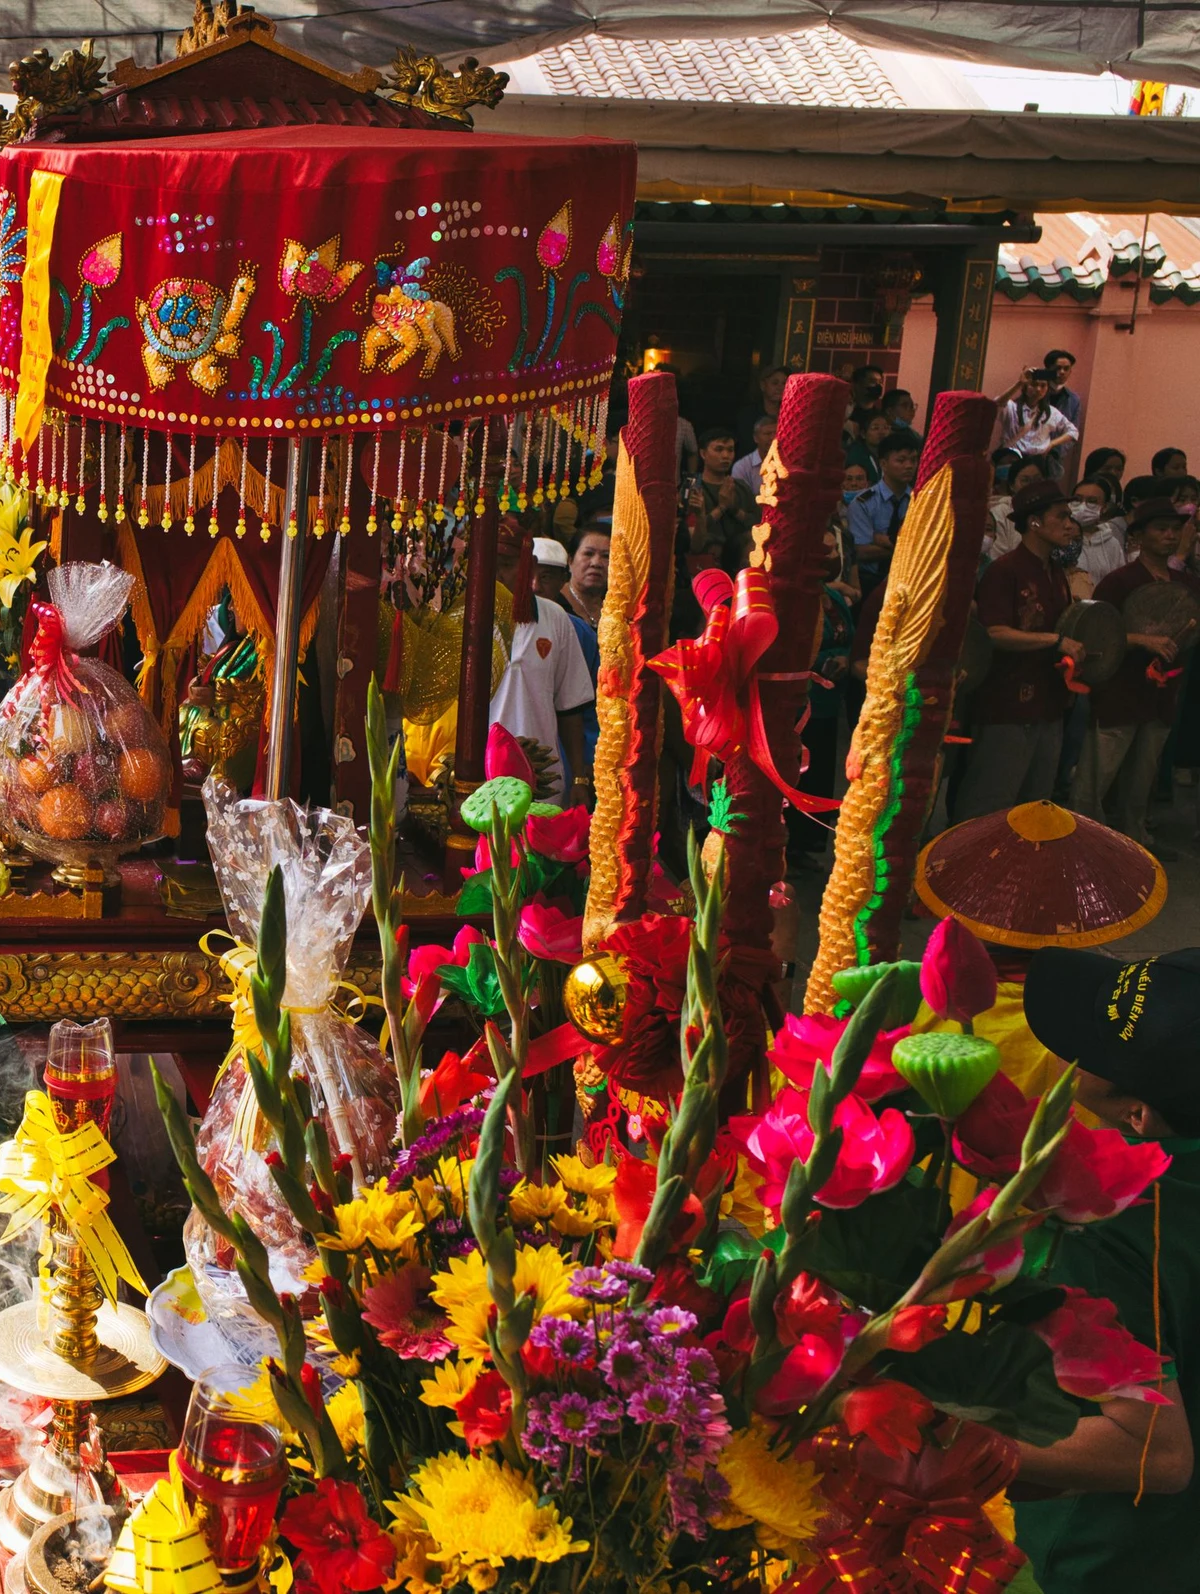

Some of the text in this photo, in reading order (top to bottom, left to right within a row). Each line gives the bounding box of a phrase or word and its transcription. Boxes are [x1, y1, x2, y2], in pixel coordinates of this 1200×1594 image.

[816, 329, 834, 347] ĐIỆN
[1128, 993, 1145, 1022] BIÊN
[1118, 1020, 1135, 1042] HÒA
